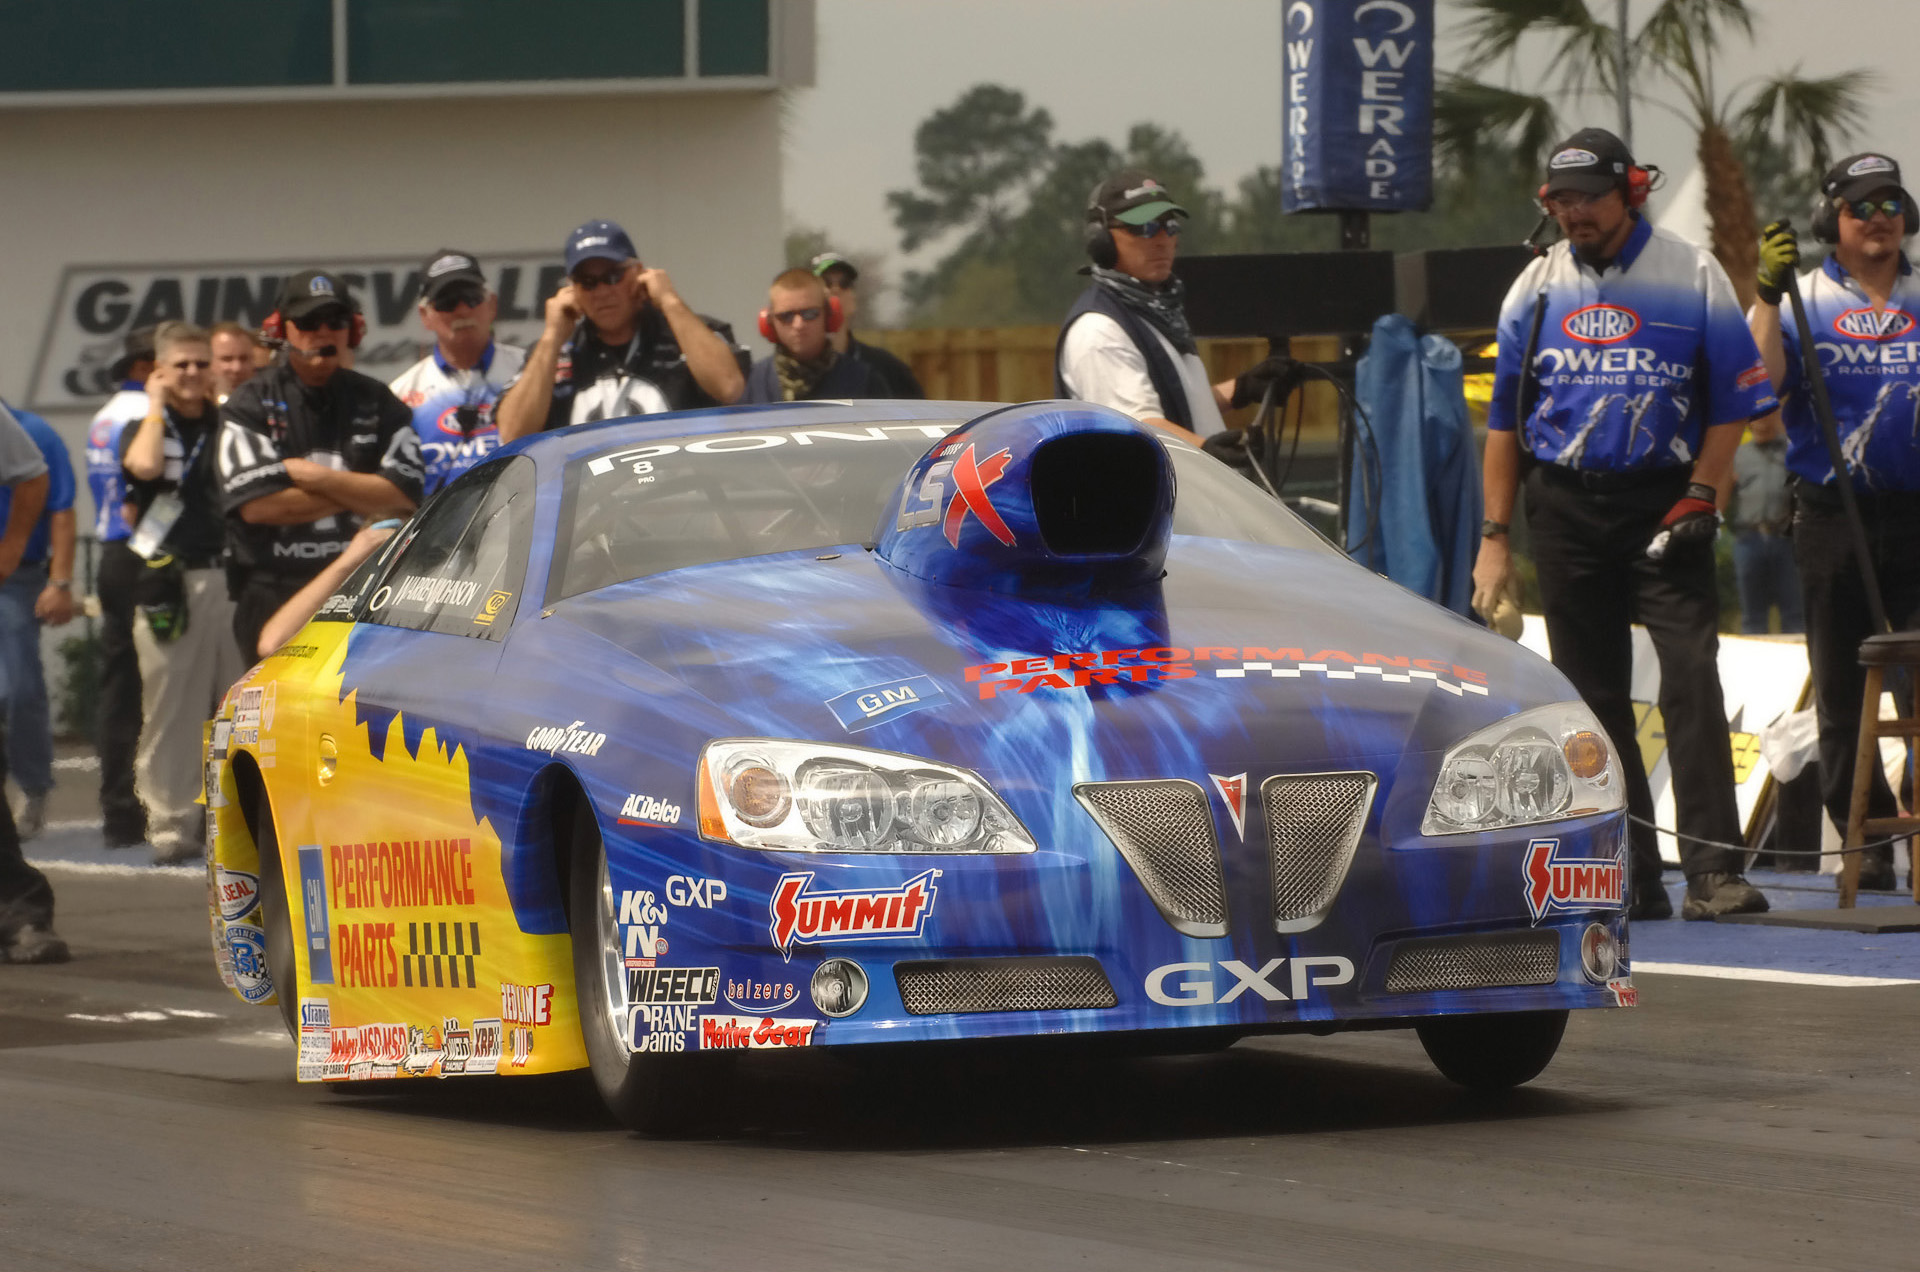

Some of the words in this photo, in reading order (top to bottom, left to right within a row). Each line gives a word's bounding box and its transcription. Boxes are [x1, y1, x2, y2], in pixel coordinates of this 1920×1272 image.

[1573, 307, 1633, 338] NHRA
[1557, 374, 1628, 386] RACING
[1838, 365, 1910, 375] RACING
[632, 460, 654, 475] 8
[638, 475, 655, 485] PRO
[896, 442, 1017, 550] LSX
[963, 646, 1489, 686] PERFORMANCE
[978, 662, 1197, 701] PARTS
[855, 685, 918, 713] GM
[620, 793, 681, 824] ACDelco
[330, 838, 475, 910] PERFORMANCE
[225, 880, 254, 901] SEAL
[665, 875, 727, 909] GXP
[338, 923, 398, 989] PARTS
[629, 969, 717, 1002] WISECO
[728, 979, 794, 999] balzers
[1144, 957, 1355, 1006] GXP
[301, 1002, 331, 1026] Strange
[359, 1026, 381, 1060] MSD
[382, 1026, 407, 1060] MSD
[475, 1027, 494, 1059] XRP
[753, 1017, 812, 1047] Gear
